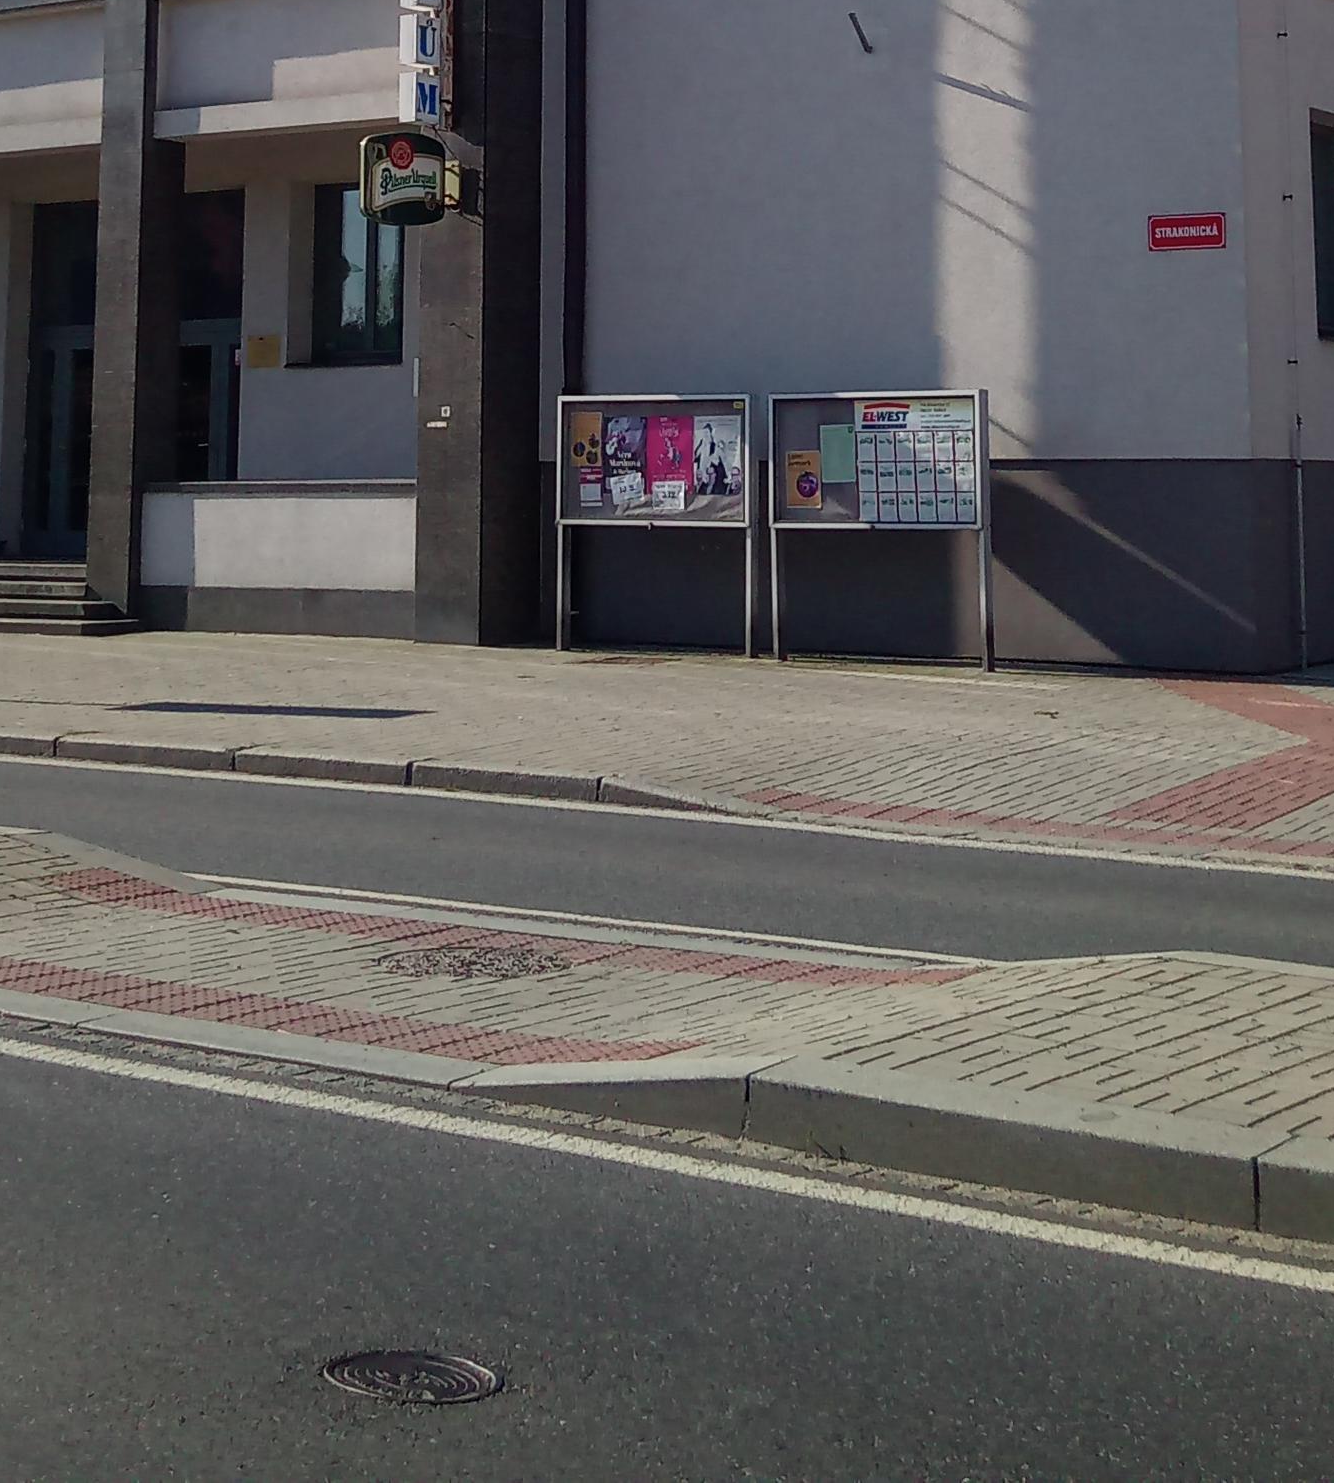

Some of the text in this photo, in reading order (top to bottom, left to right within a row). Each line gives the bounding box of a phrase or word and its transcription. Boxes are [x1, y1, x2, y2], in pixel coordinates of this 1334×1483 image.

[380, 167, 437, 196] Pilsner Urquell
[1154, 222, 1219, 239] STRAKONICKÁ
